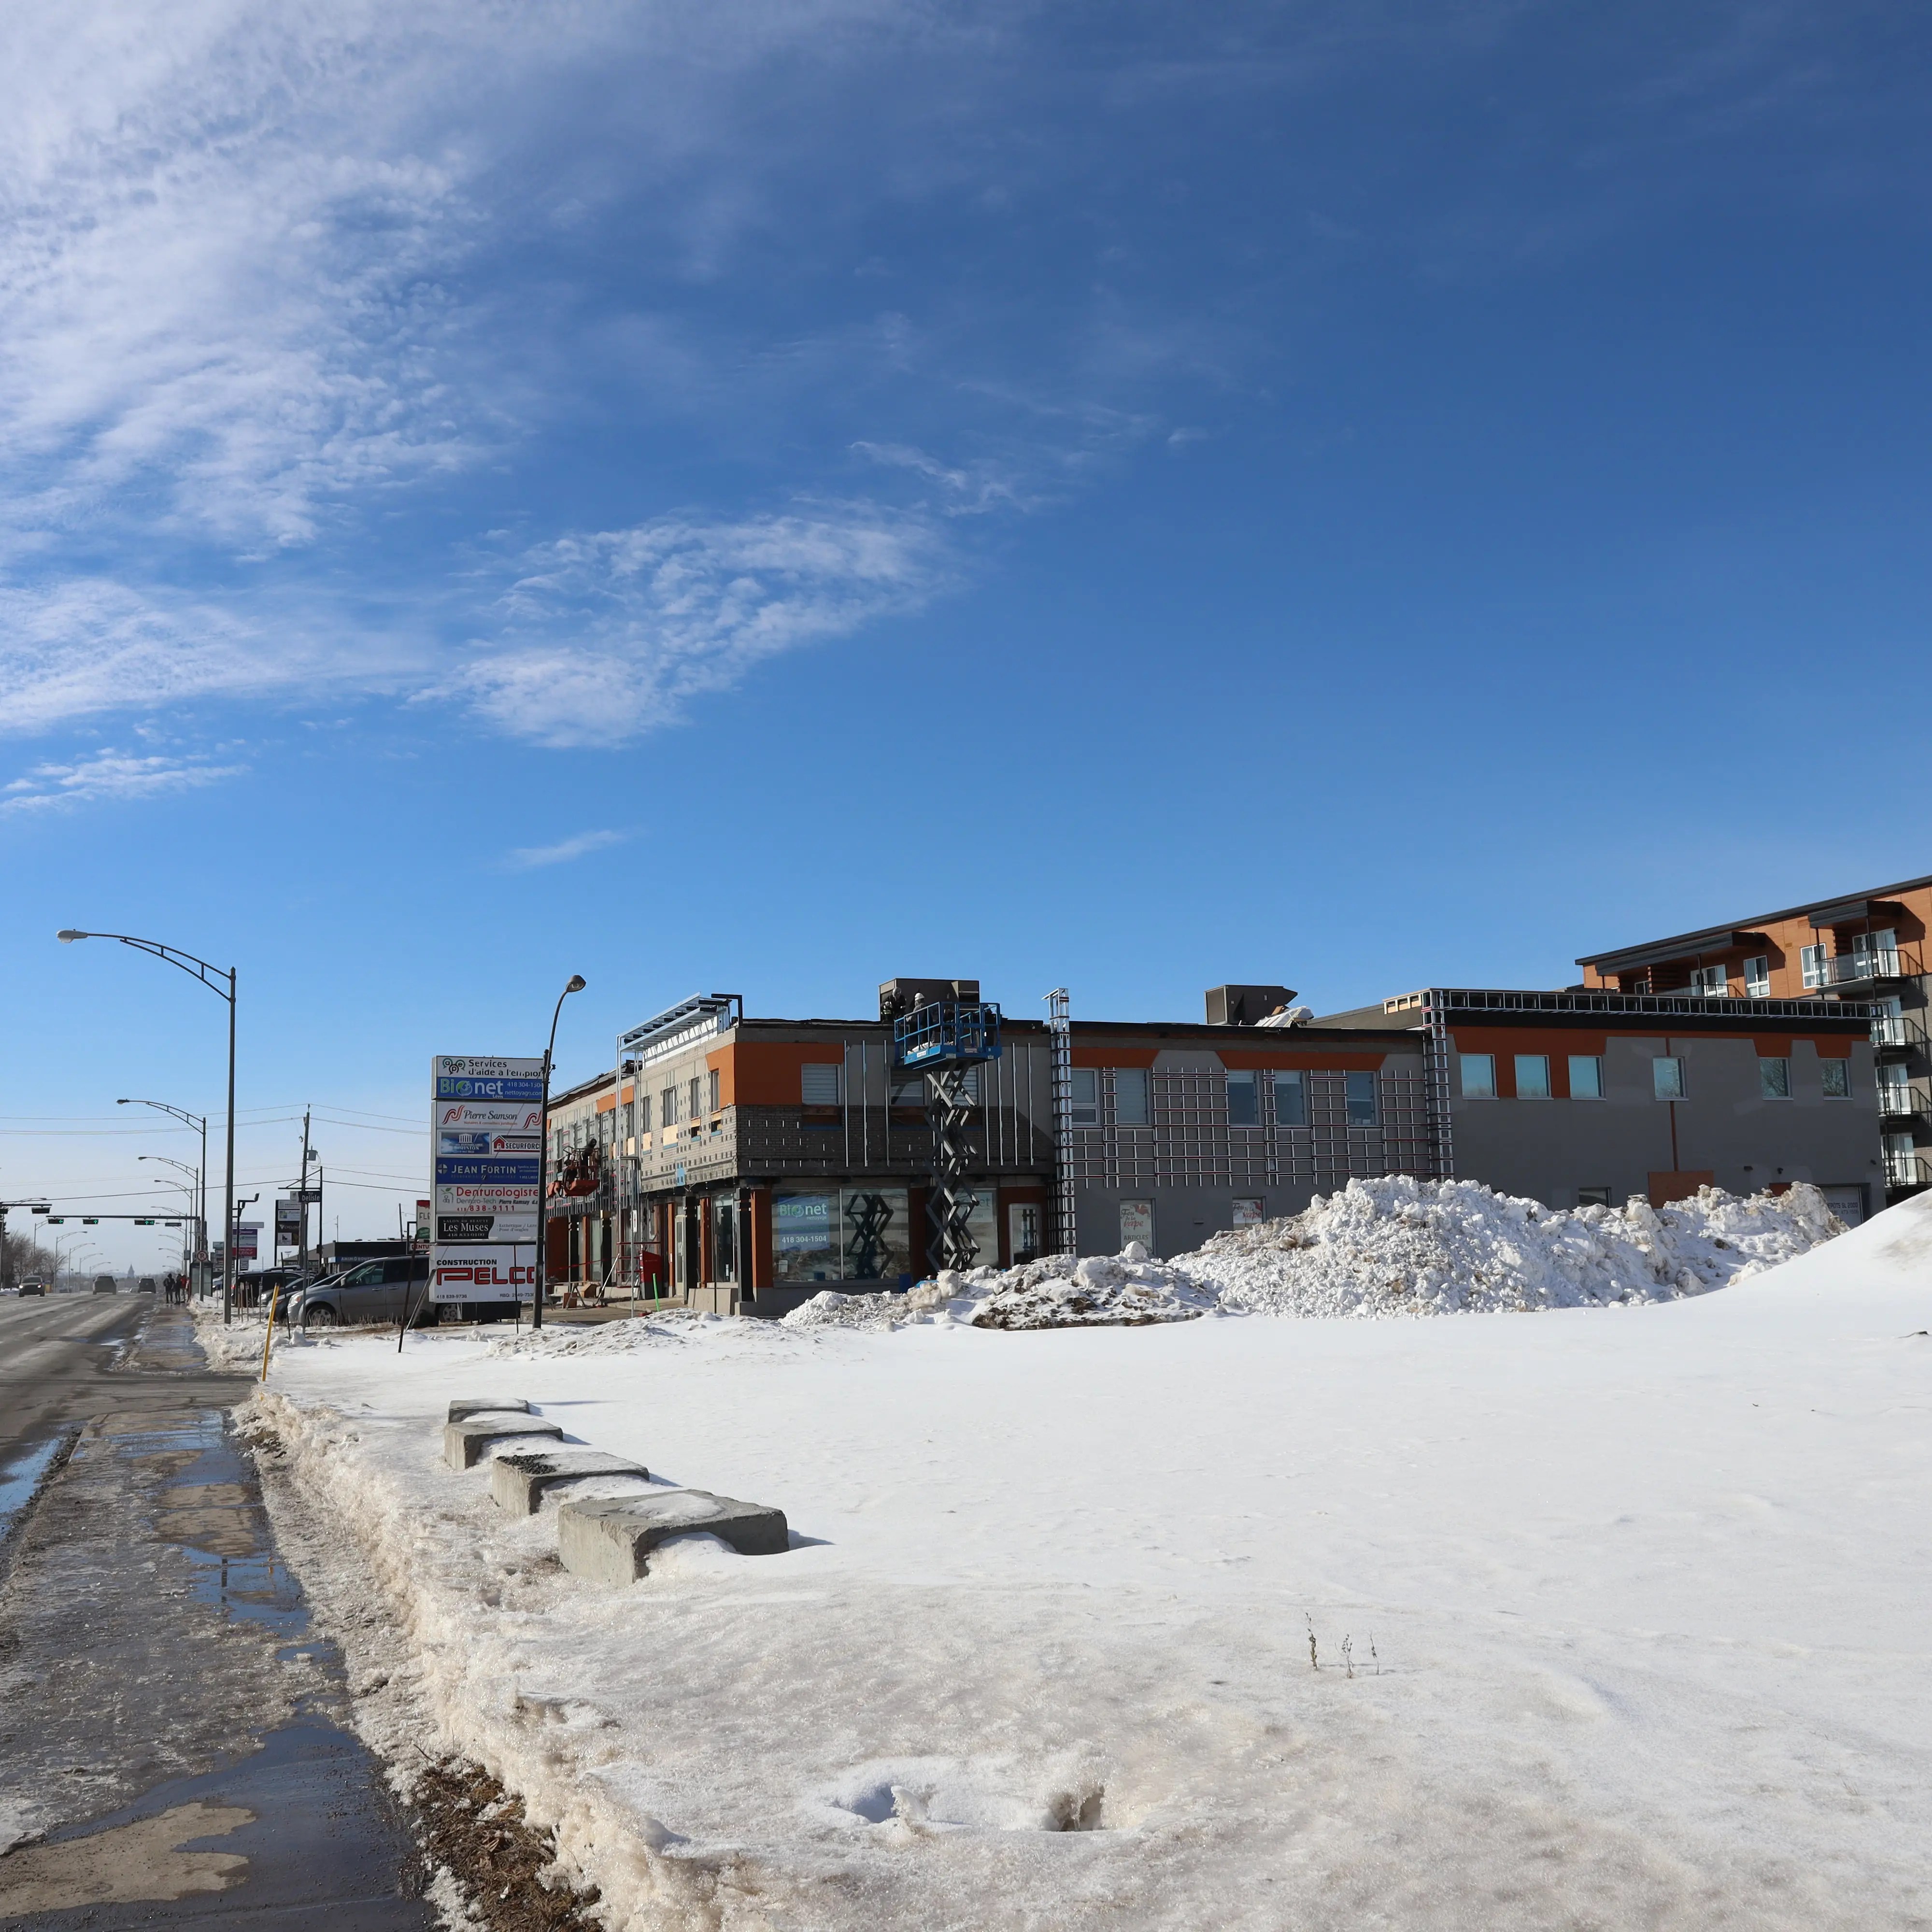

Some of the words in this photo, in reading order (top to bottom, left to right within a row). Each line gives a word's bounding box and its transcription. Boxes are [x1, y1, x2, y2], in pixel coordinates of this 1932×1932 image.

[464, 1110, 486, 1119] Pierre
[488, 1110, 518, 1120] Samson
[451, 1165, 477, 1174] JEAN
[481, 1165, 516, 1174] FORTIN
[456, 1187, 538, 1199] Denturologiste
[443, 1223, 458, 1232] Les
[461, 1222, 488, 1232] Muses
